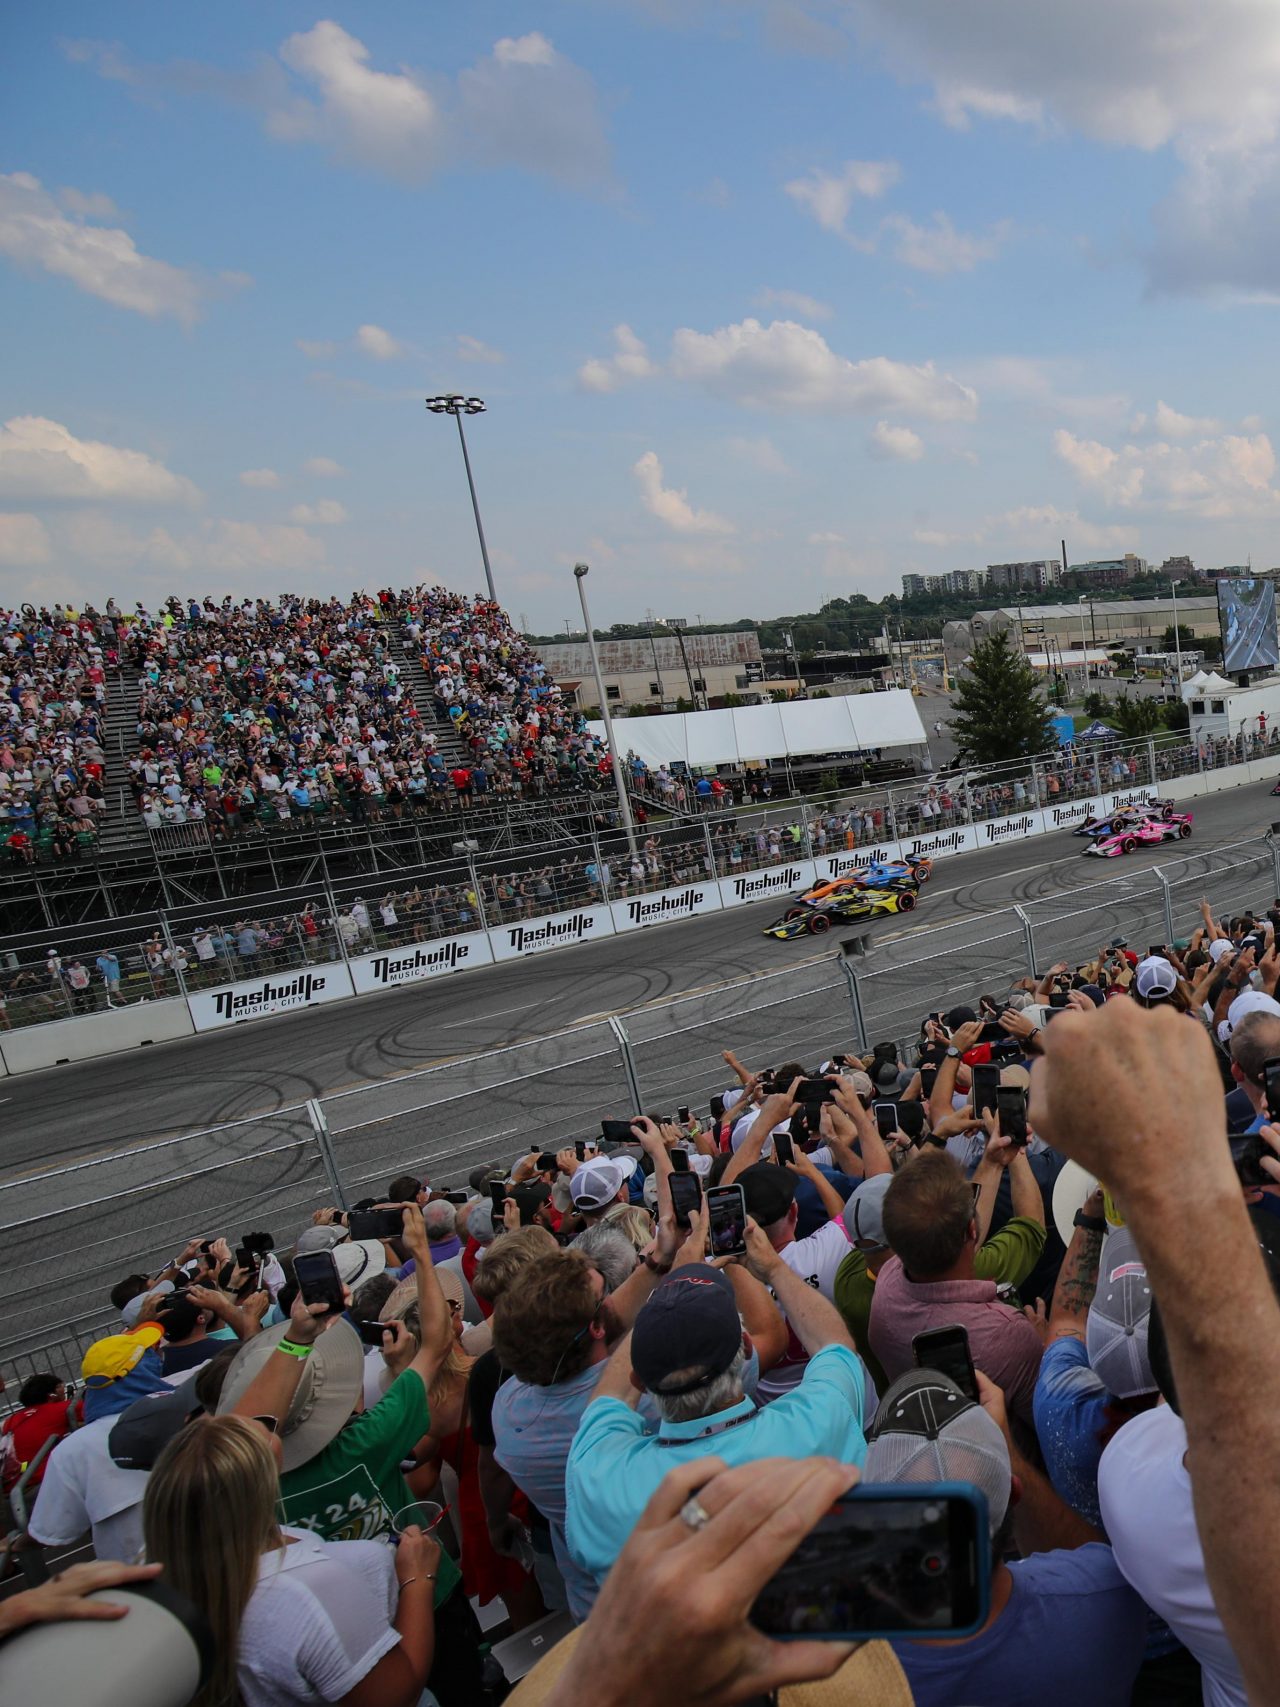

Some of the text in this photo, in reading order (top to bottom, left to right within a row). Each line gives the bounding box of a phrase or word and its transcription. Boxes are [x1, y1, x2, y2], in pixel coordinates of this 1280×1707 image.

[1052, 802, 1095, 825] Nashville
[985, 816, 1033, 841] Nashville
[912, 831, 965, 855] Nashville
[828, 849, 888, 877] Nashville
[733, 868, 801, 899] Nashville
[746, 884, 788, 898] MUSIC CITY
[627, 889, 704, 923] Nashville
[641, 907, 689, 922] MUSIC CITY
[507, 914, 594, 951] Nashville
[524, 932, 577, 950] MUSIC CITY
[370, 941, 469, 982] Nashville
[389, 962, 452, 981] MUSIC CITY
[212, 974, 326, 1019] Nashville
[234, 995, 304, 1017] MUSIC CITY
[326, 1491, 367, 1523] 24
